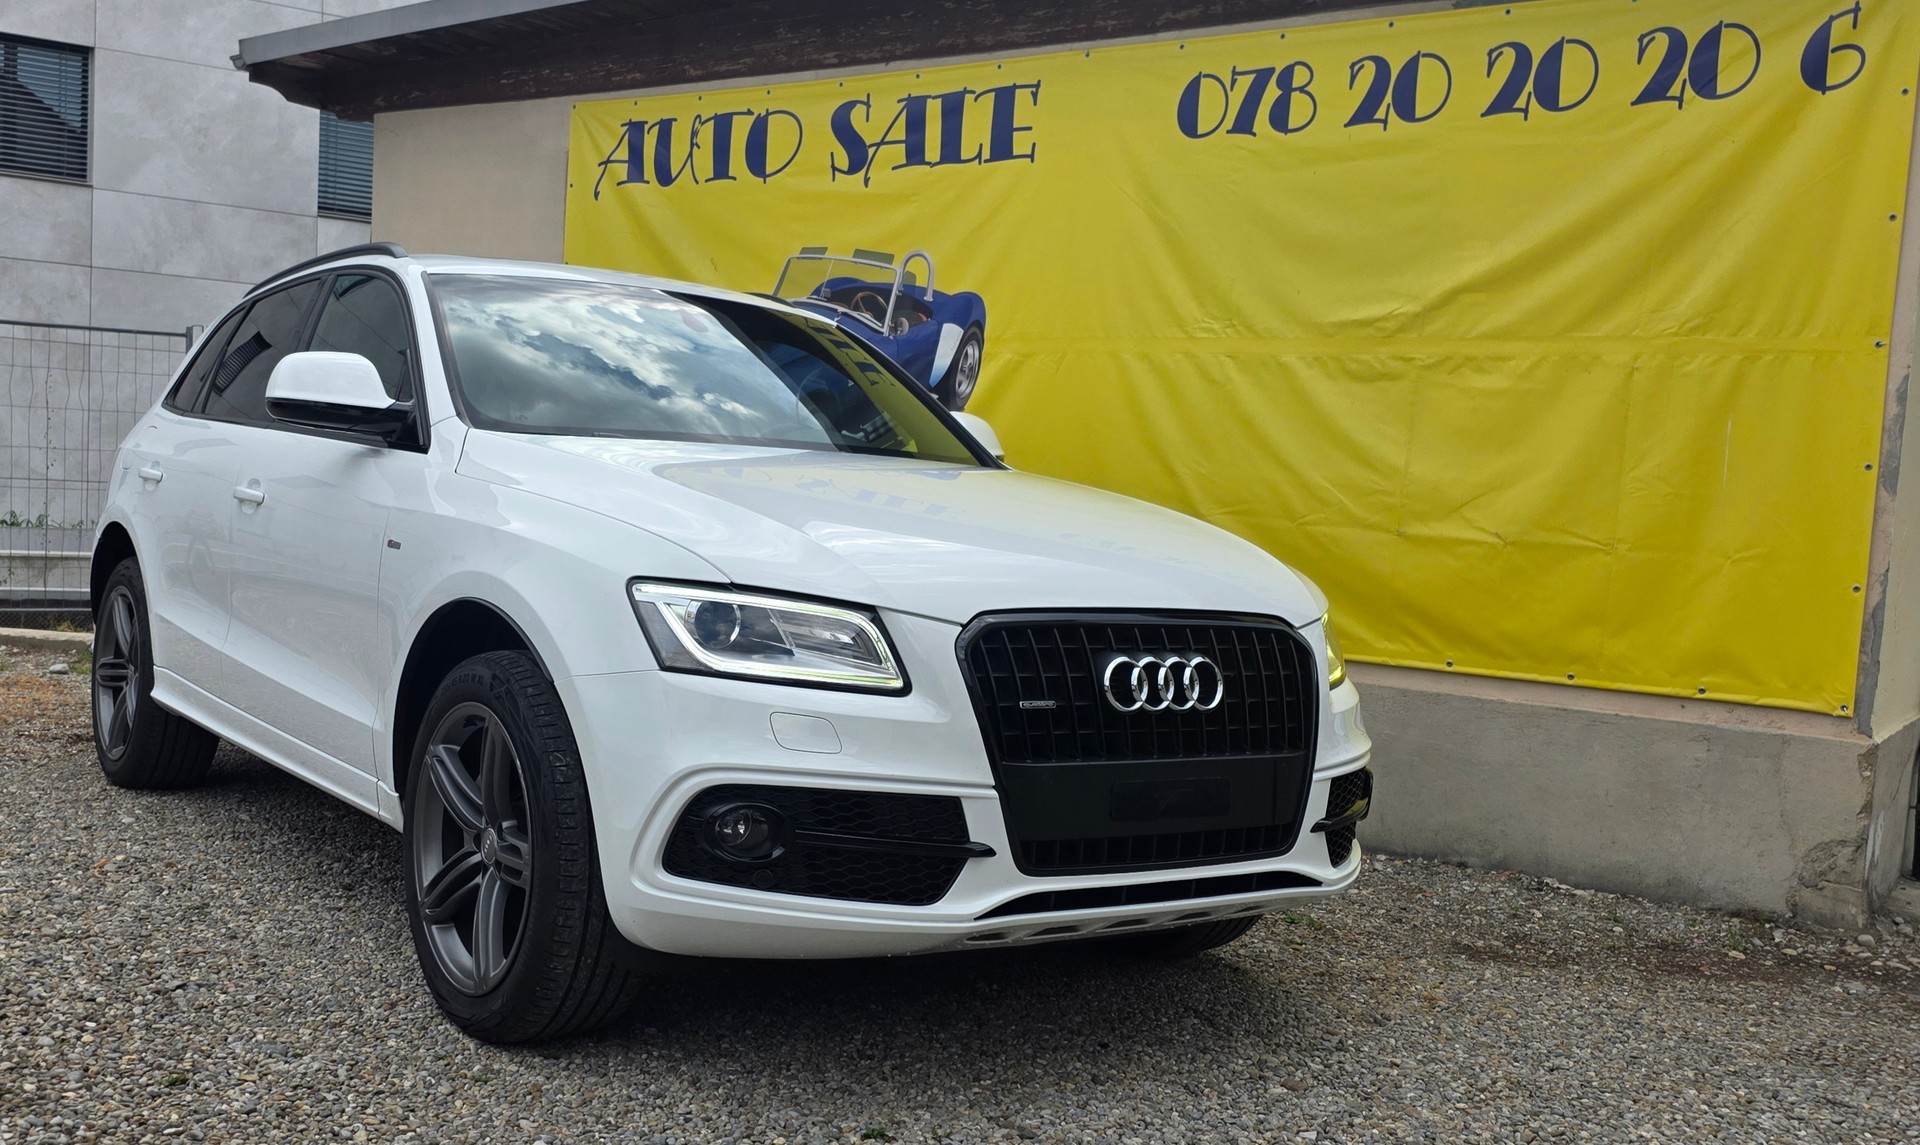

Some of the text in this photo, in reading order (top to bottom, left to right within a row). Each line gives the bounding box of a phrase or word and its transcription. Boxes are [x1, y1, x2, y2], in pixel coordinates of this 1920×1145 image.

[1177, 1, 1866, 138] 078 20 20 20 6
[594, 80, 1041, 200] AUTO SALE
